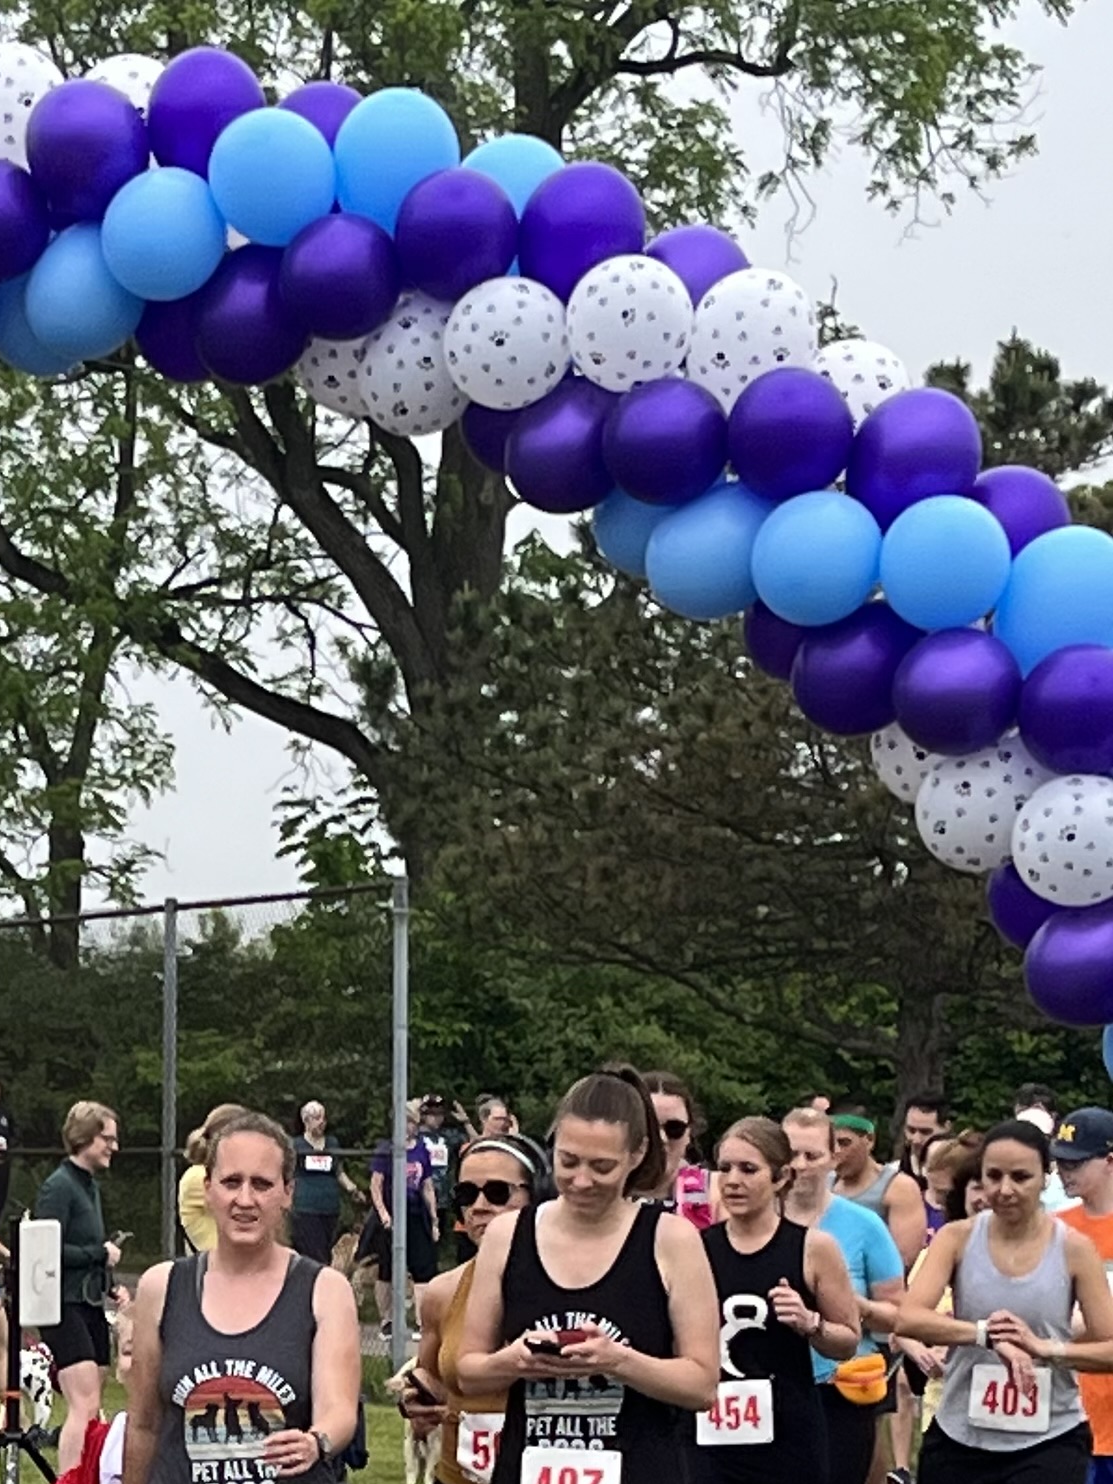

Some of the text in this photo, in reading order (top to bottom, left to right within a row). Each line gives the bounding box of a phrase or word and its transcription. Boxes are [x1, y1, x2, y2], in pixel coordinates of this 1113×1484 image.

[534, 1314, 563, 1332] ALL
[599, 1318, 630, 1345] MIL
[194, 1361, 222, 1385] ALL
[225, 1359, 256, 1378] THE
[708, 1395, 761, 1430] 454
[527, 1416, 617, 1439] PET ALL THE
[192, 1459, 277, 1482] PET ALL TH
